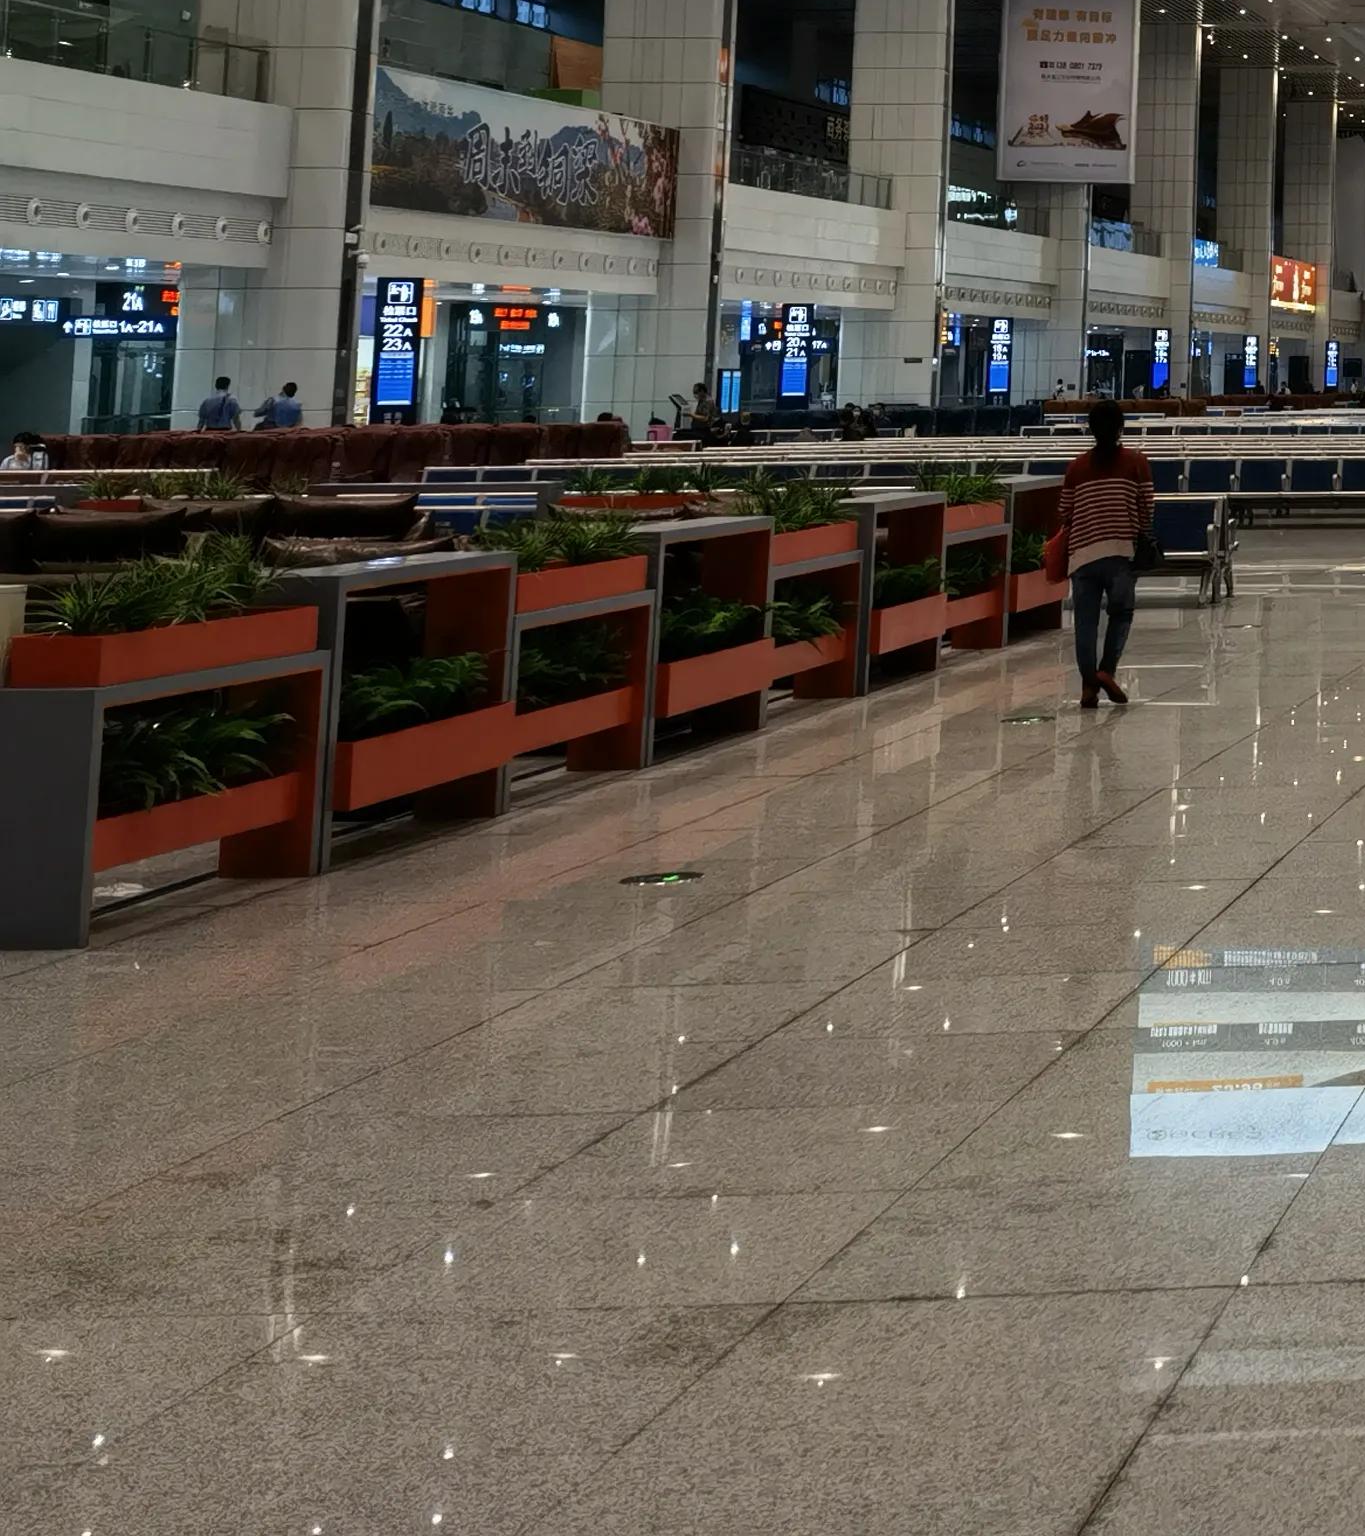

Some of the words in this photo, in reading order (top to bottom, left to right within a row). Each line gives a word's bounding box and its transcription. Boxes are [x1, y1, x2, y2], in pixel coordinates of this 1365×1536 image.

[122, 292, 144, 311] 21A
[383, 306, 416, 316] 检票口
[119, 320, 164, 333] 1A-21A
[383, 324, 412, 337] 22A
[382, 338, 412, 351] 23A
[786, 337, 806, 347] 20A
[785, 348, 806, 357] 21A
